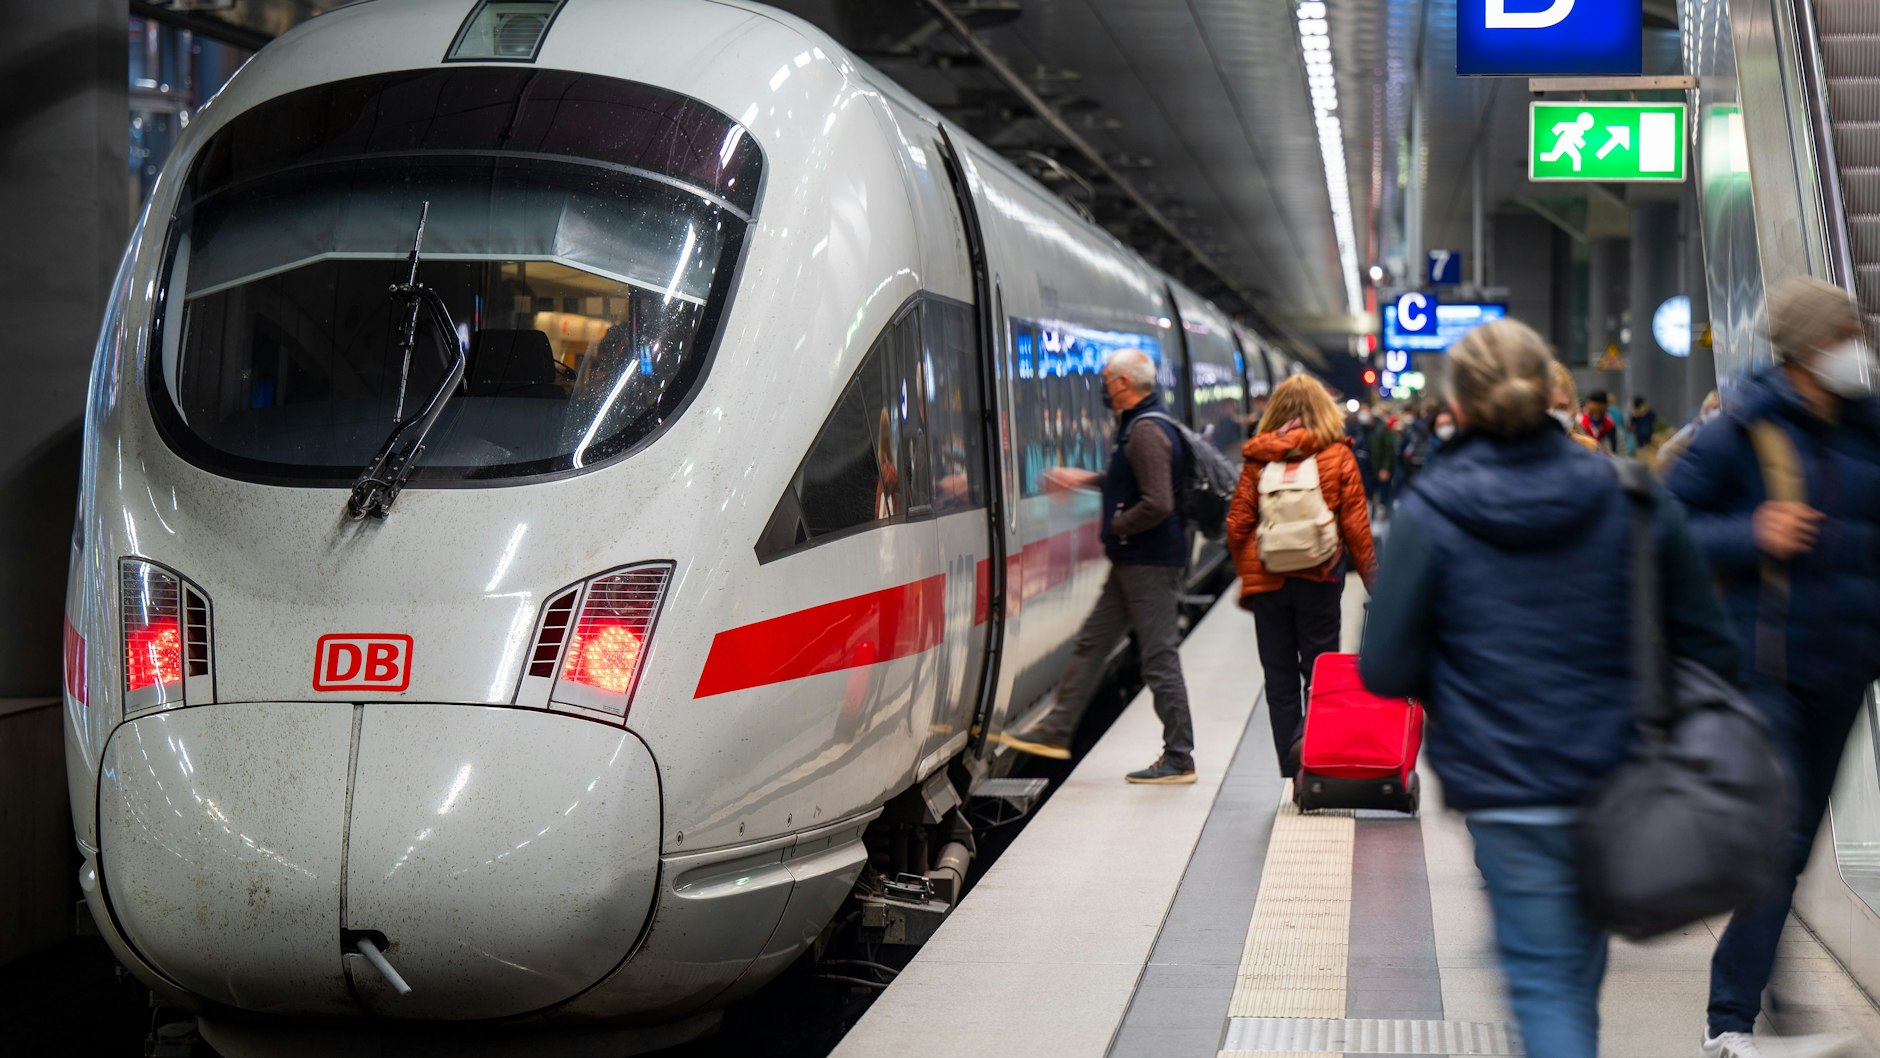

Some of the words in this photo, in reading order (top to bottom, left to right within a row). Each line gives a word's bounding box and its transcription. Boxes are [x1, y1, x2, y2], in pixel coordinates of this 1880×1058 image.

[1429, 249, 1451, 281] 7
[1398, 292, 1427, 331] C
[325, 643, 399, 682] DB
